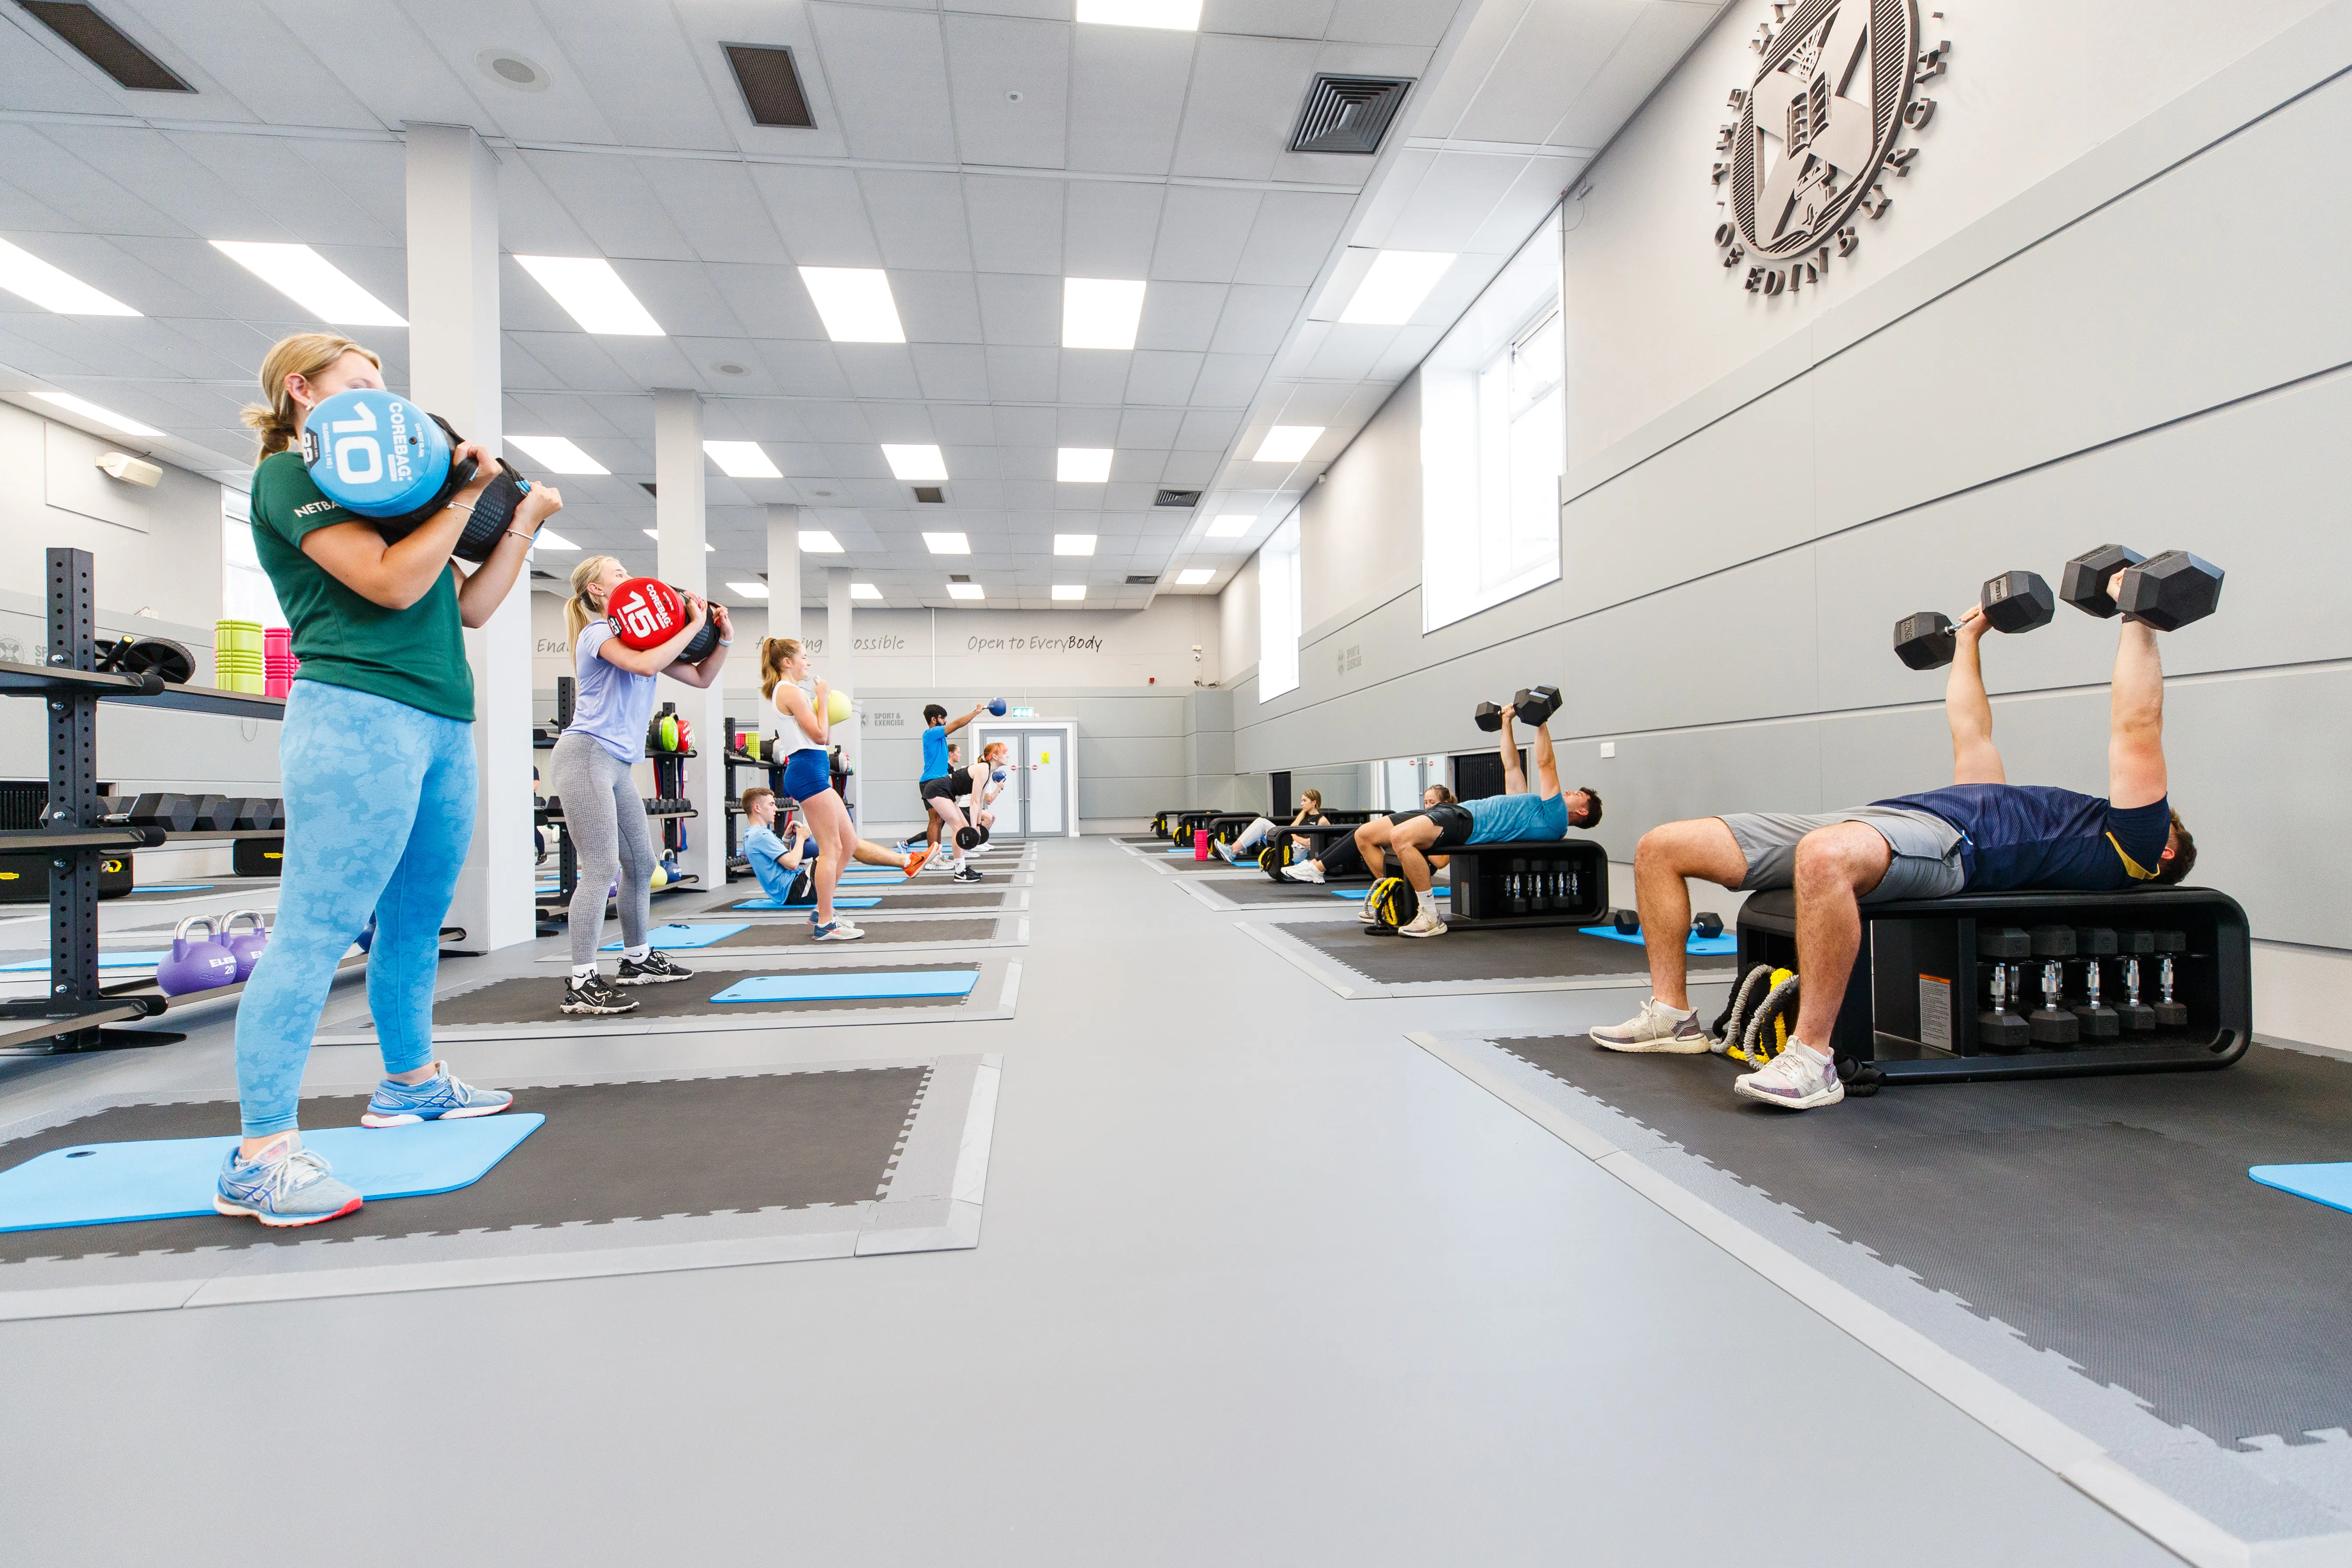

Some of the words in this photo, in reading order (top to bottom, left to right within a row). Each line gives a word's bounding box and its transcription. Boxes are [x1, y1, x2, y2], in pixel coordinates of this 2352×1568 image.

[1742, 40, 1951, 296] EDINBURGH
[1714, 221, 1745, 268] OF
[332, 402, 383, 484] 10
[294, 500, 342, 518] NETBA
[622, 590, 659, 638] 15
[1904, 620, 1913, 640] 22KG
[537, 639, 569, 653] Ena
[852, 635, 905, 650] ossible
[968, 636, 1004, 653] Open
[1009, 637, 1025, 650] to
[1029, 635, 1103, 653] EveryBody
[225, 965, 234, 975] 20
